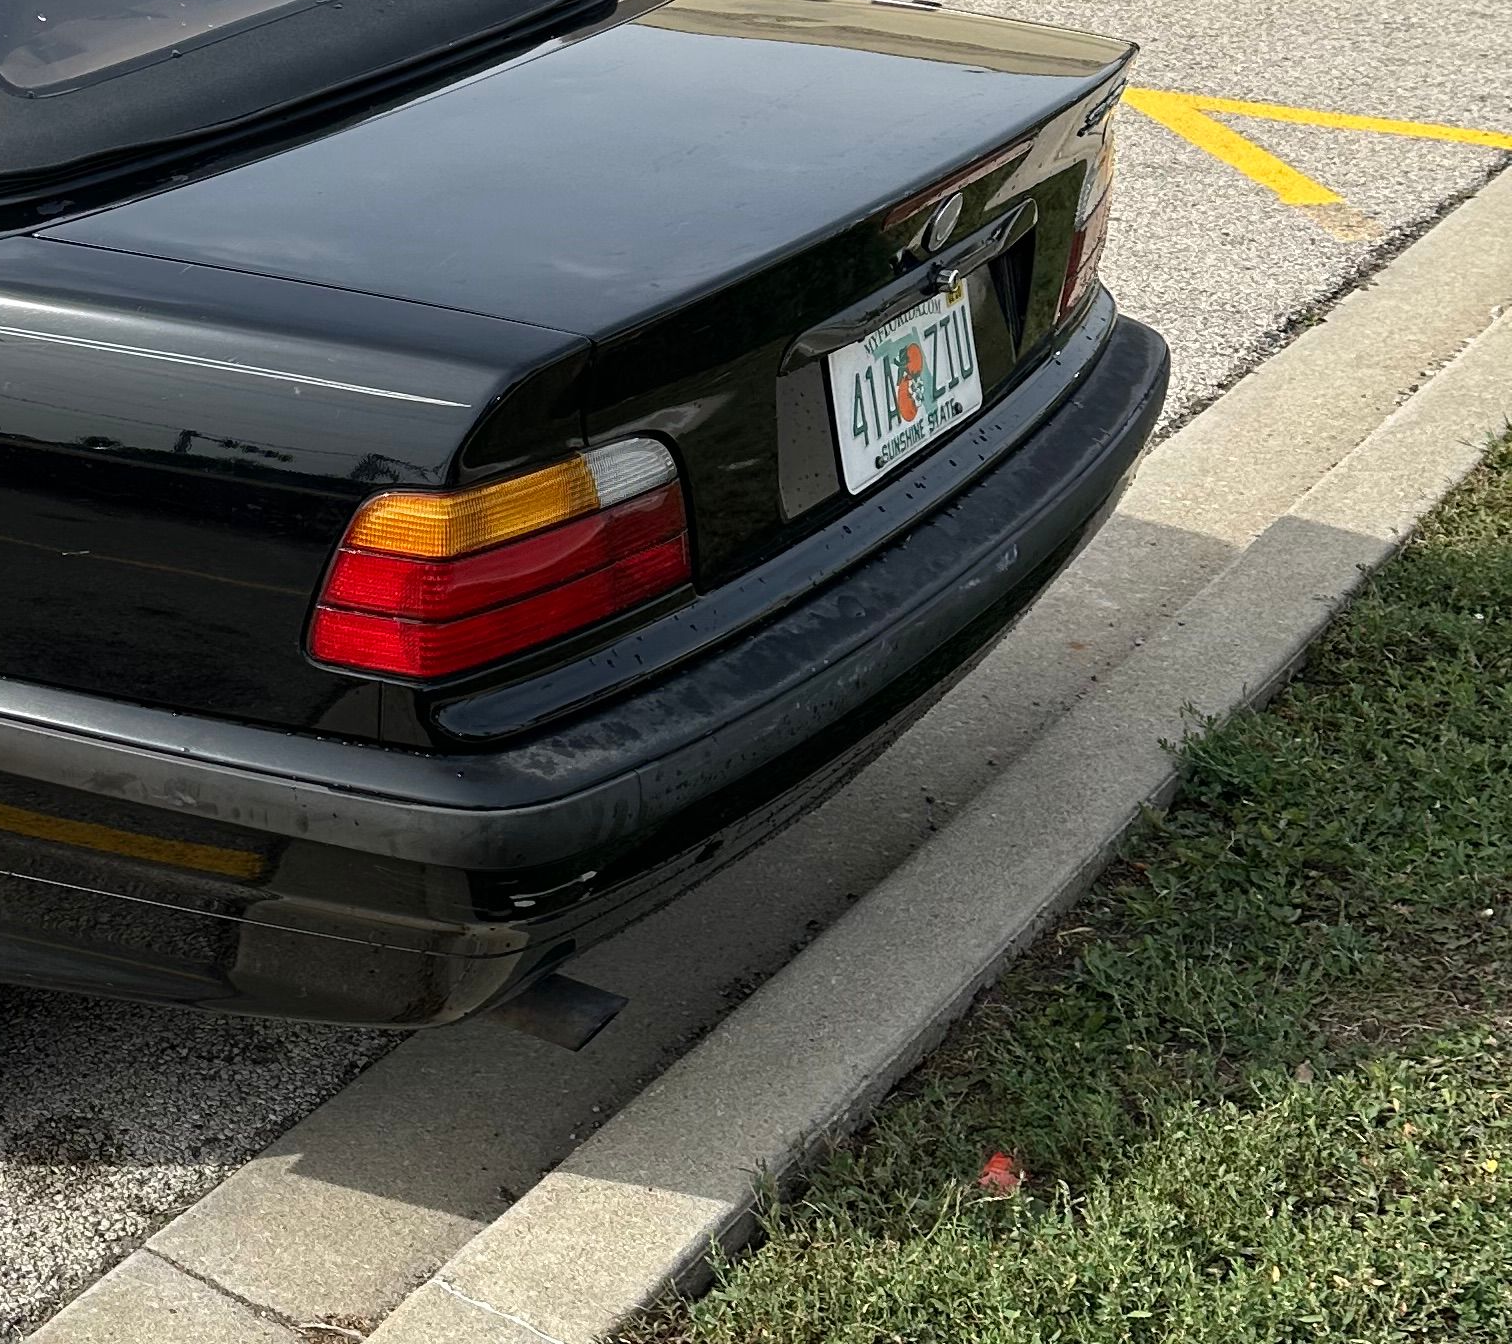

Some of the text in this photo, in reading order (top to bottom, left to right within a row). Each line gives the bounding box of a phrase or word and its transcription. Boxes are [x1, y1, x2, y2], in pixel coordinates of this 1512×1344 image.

[853, 304, 974, 448] 41A ZIU
[881, 398, 957, 464] SUNSHINE STATE
